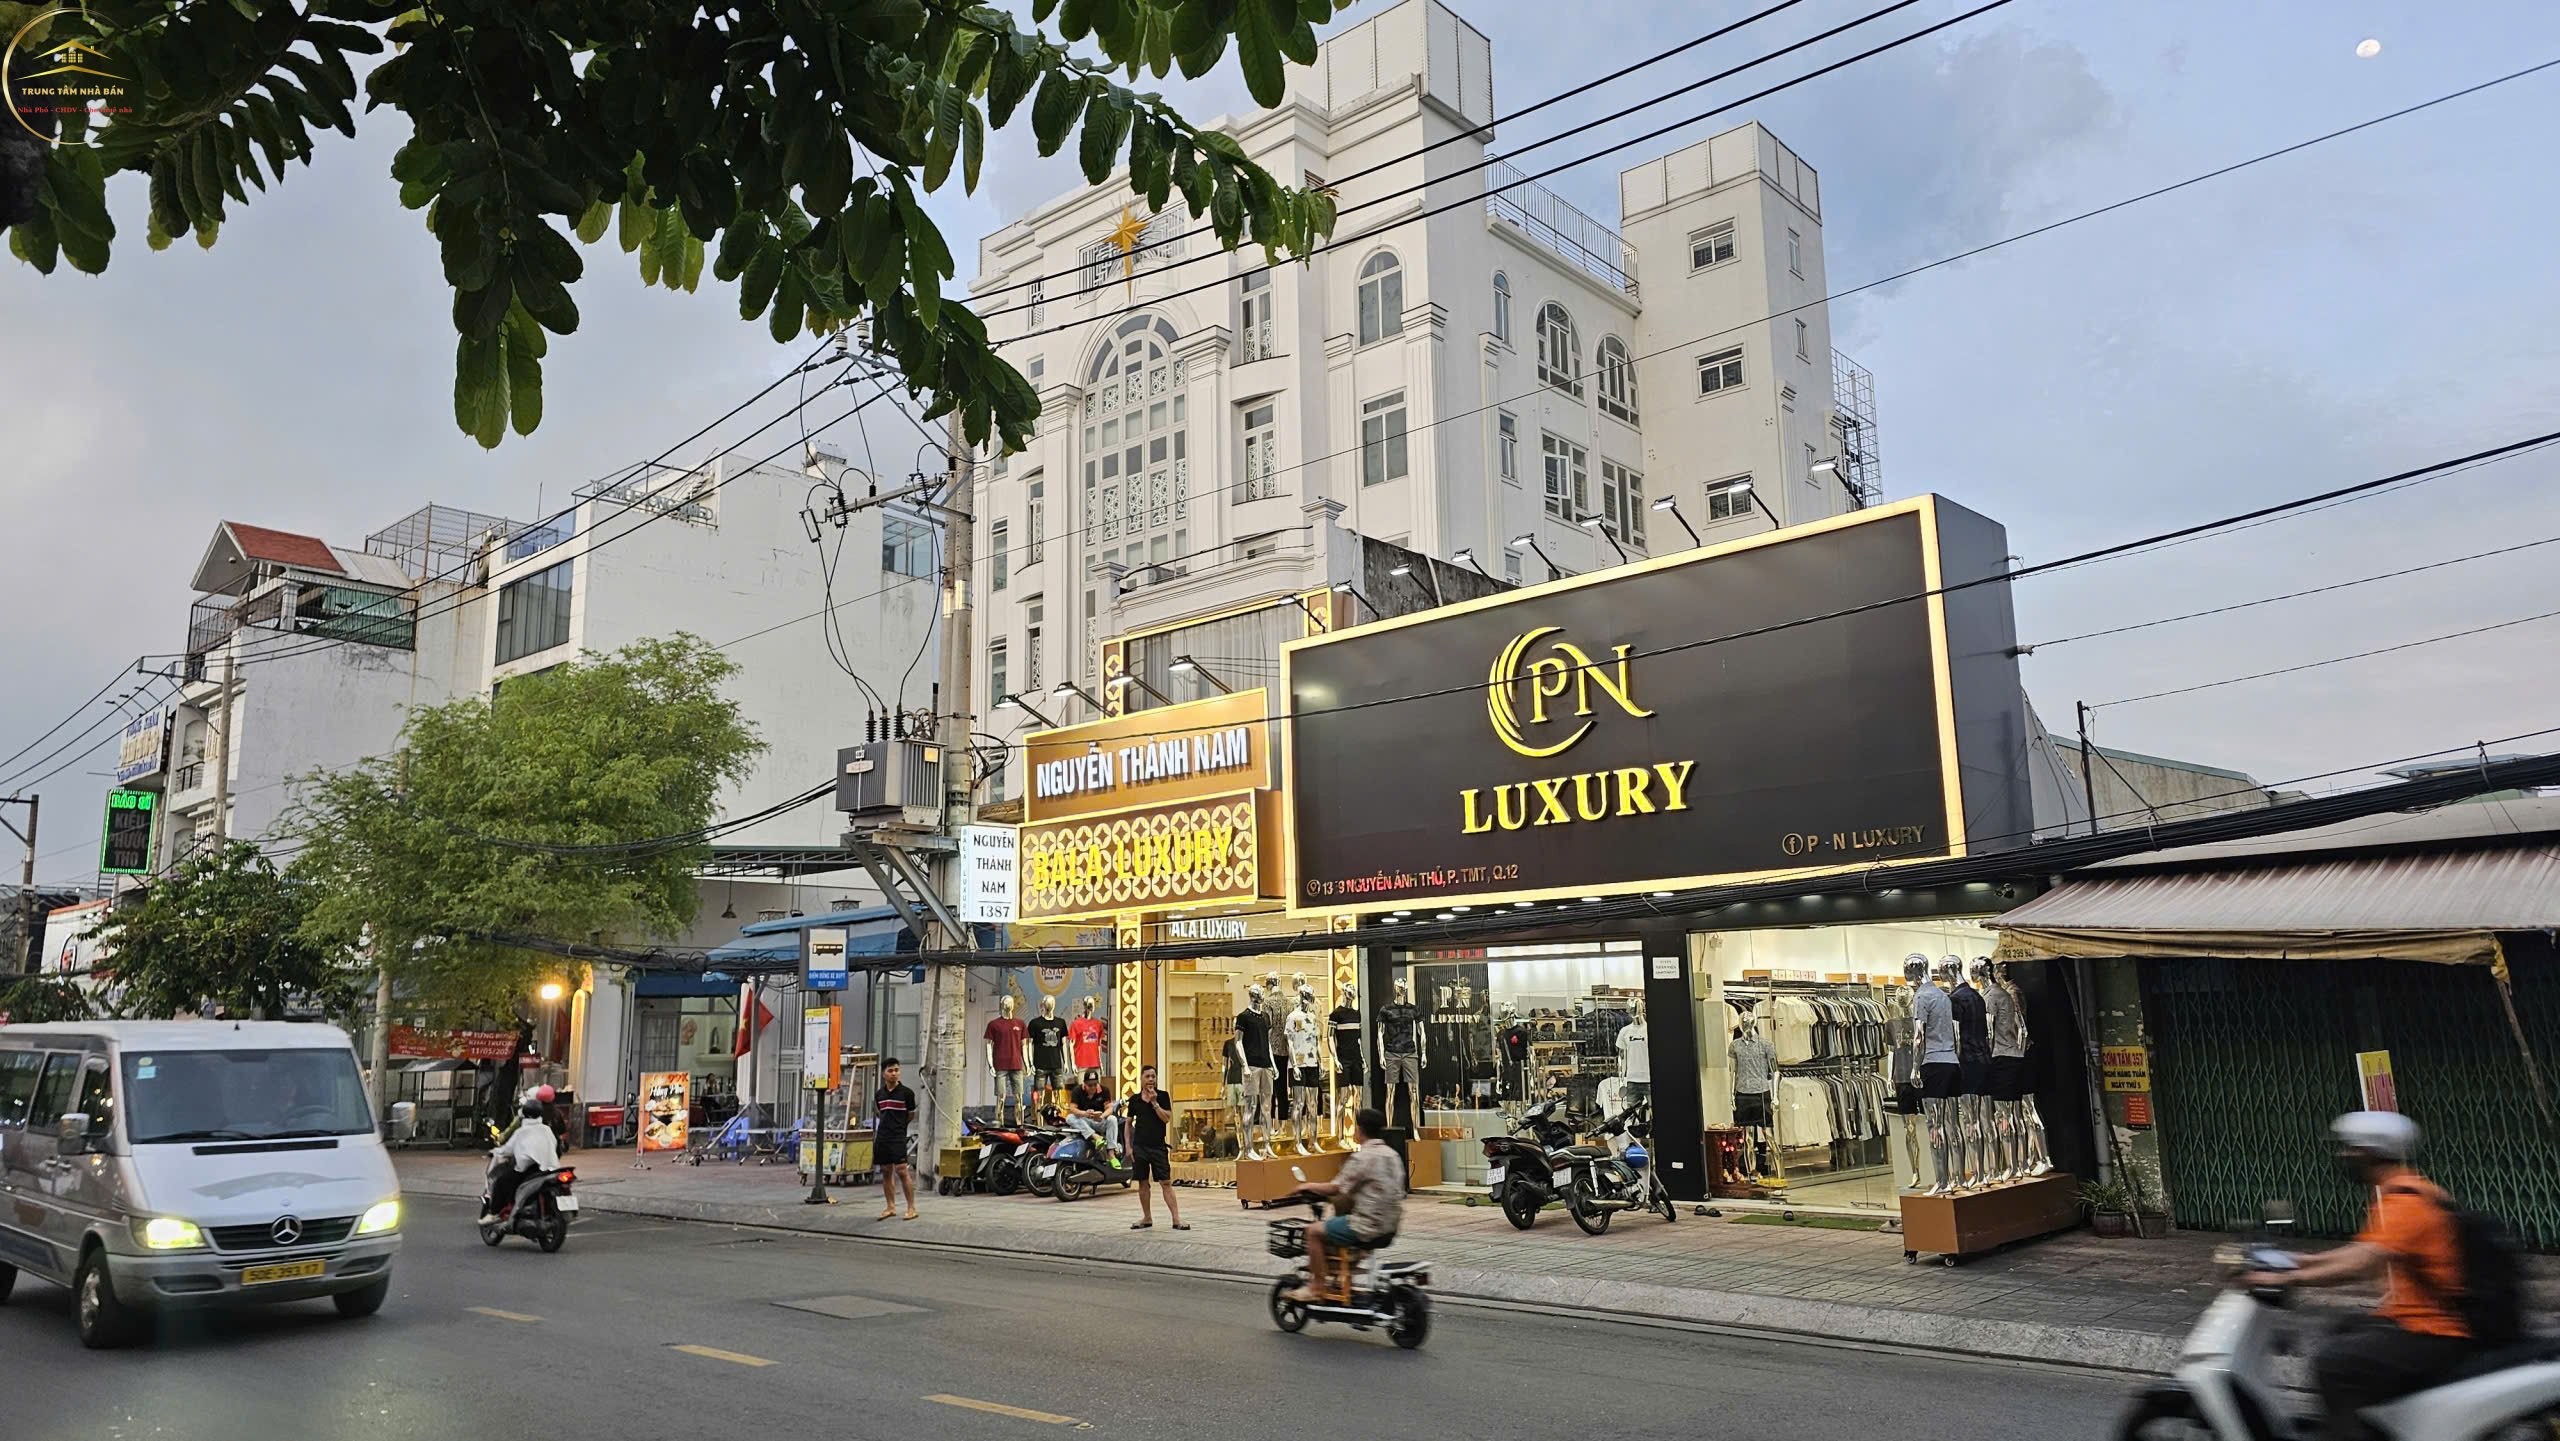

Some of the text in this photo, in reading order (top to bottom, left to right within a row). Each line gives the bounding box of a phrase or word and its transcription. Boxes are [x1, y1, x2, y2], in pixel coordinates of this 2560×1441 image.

[1037, 727, 1250, 797] NGUYỄN THÀNH NAM
[1460, 760, 1695, 834] LUXURY
[973, 831, 1015, 849] NGUYỄN
[1807, 835, 1819, 852] P
[1833, 832, 1847, 851] N
[1852, 825, 1925, 849] LUXURY
[1033, 825, 1233, 890] BALA LUXURY
[982, 880, 1006, 894] NAM
[1322, 878, 1345, 895] 139
[1492, 864, 1519, 880] Q.12
[980, 905, 1010, 918] 1387
[1169, 919, 1248, 940] ALA LUXURY
[1430, 1014, 1481, 1024] LUXURY
